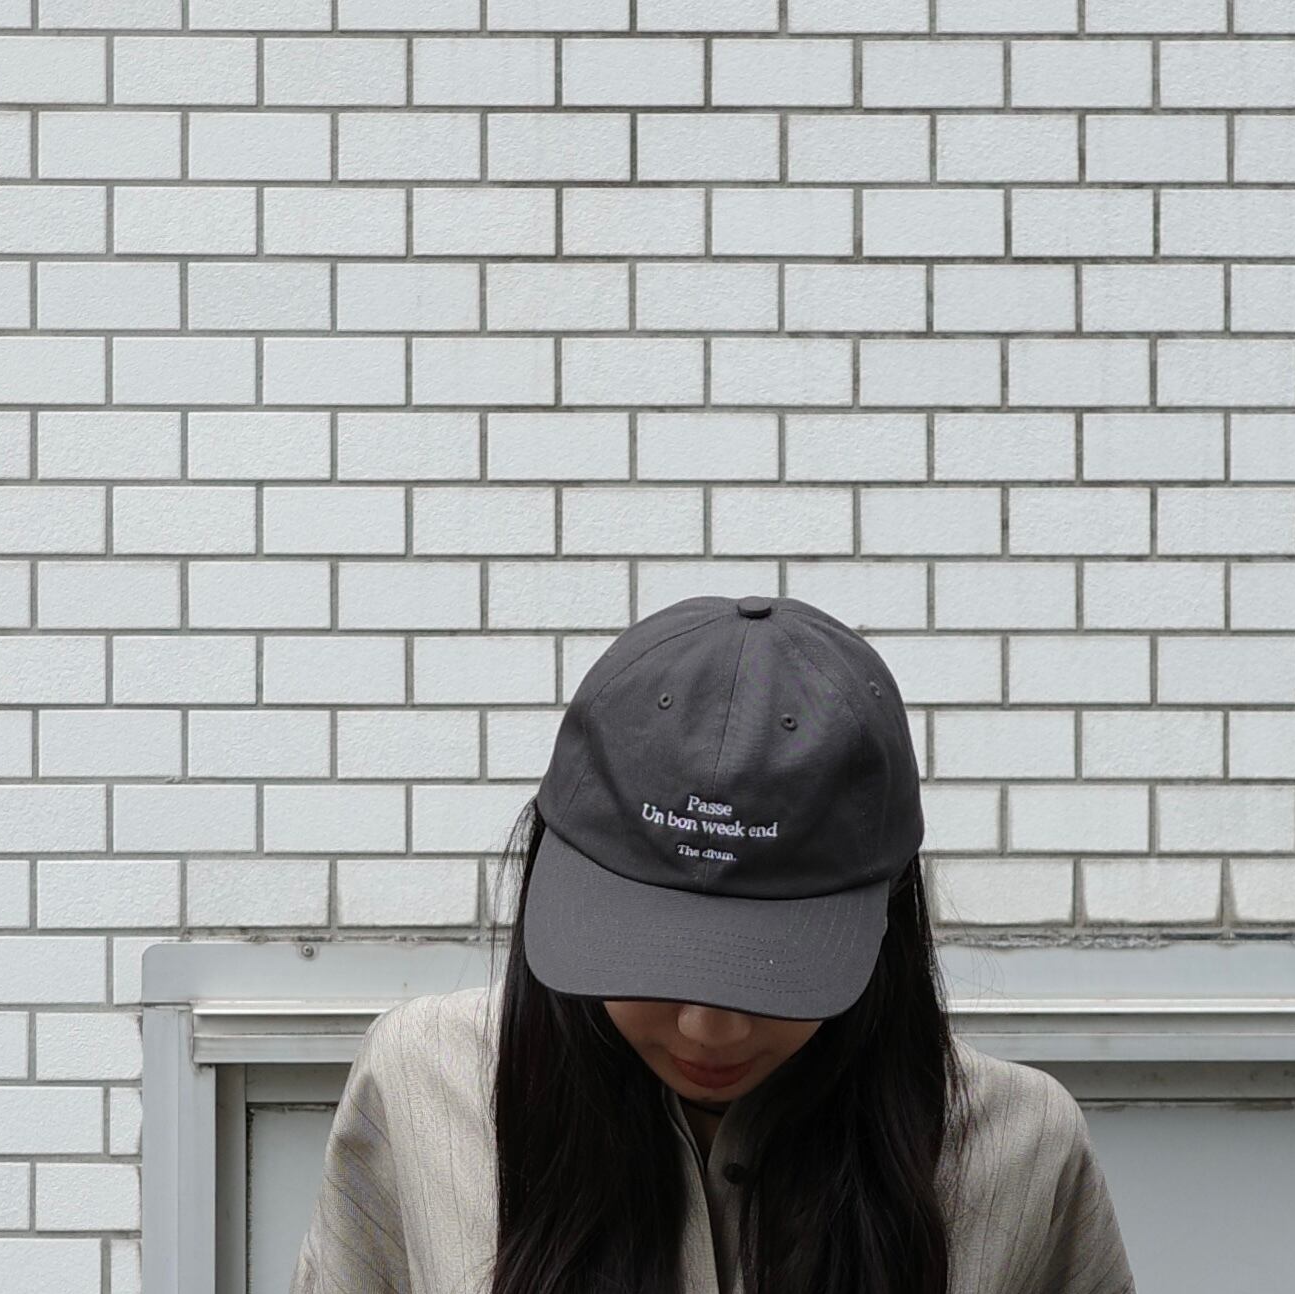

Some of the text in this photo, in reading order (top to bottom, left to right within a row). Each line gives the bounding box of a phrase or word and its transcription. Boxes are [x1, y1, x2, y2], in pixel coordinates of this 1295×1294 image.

[687, 795, 732, 816] Passe
[641, 803, 778, 838] Un bon week end
[677, 844, 700, 857] The
